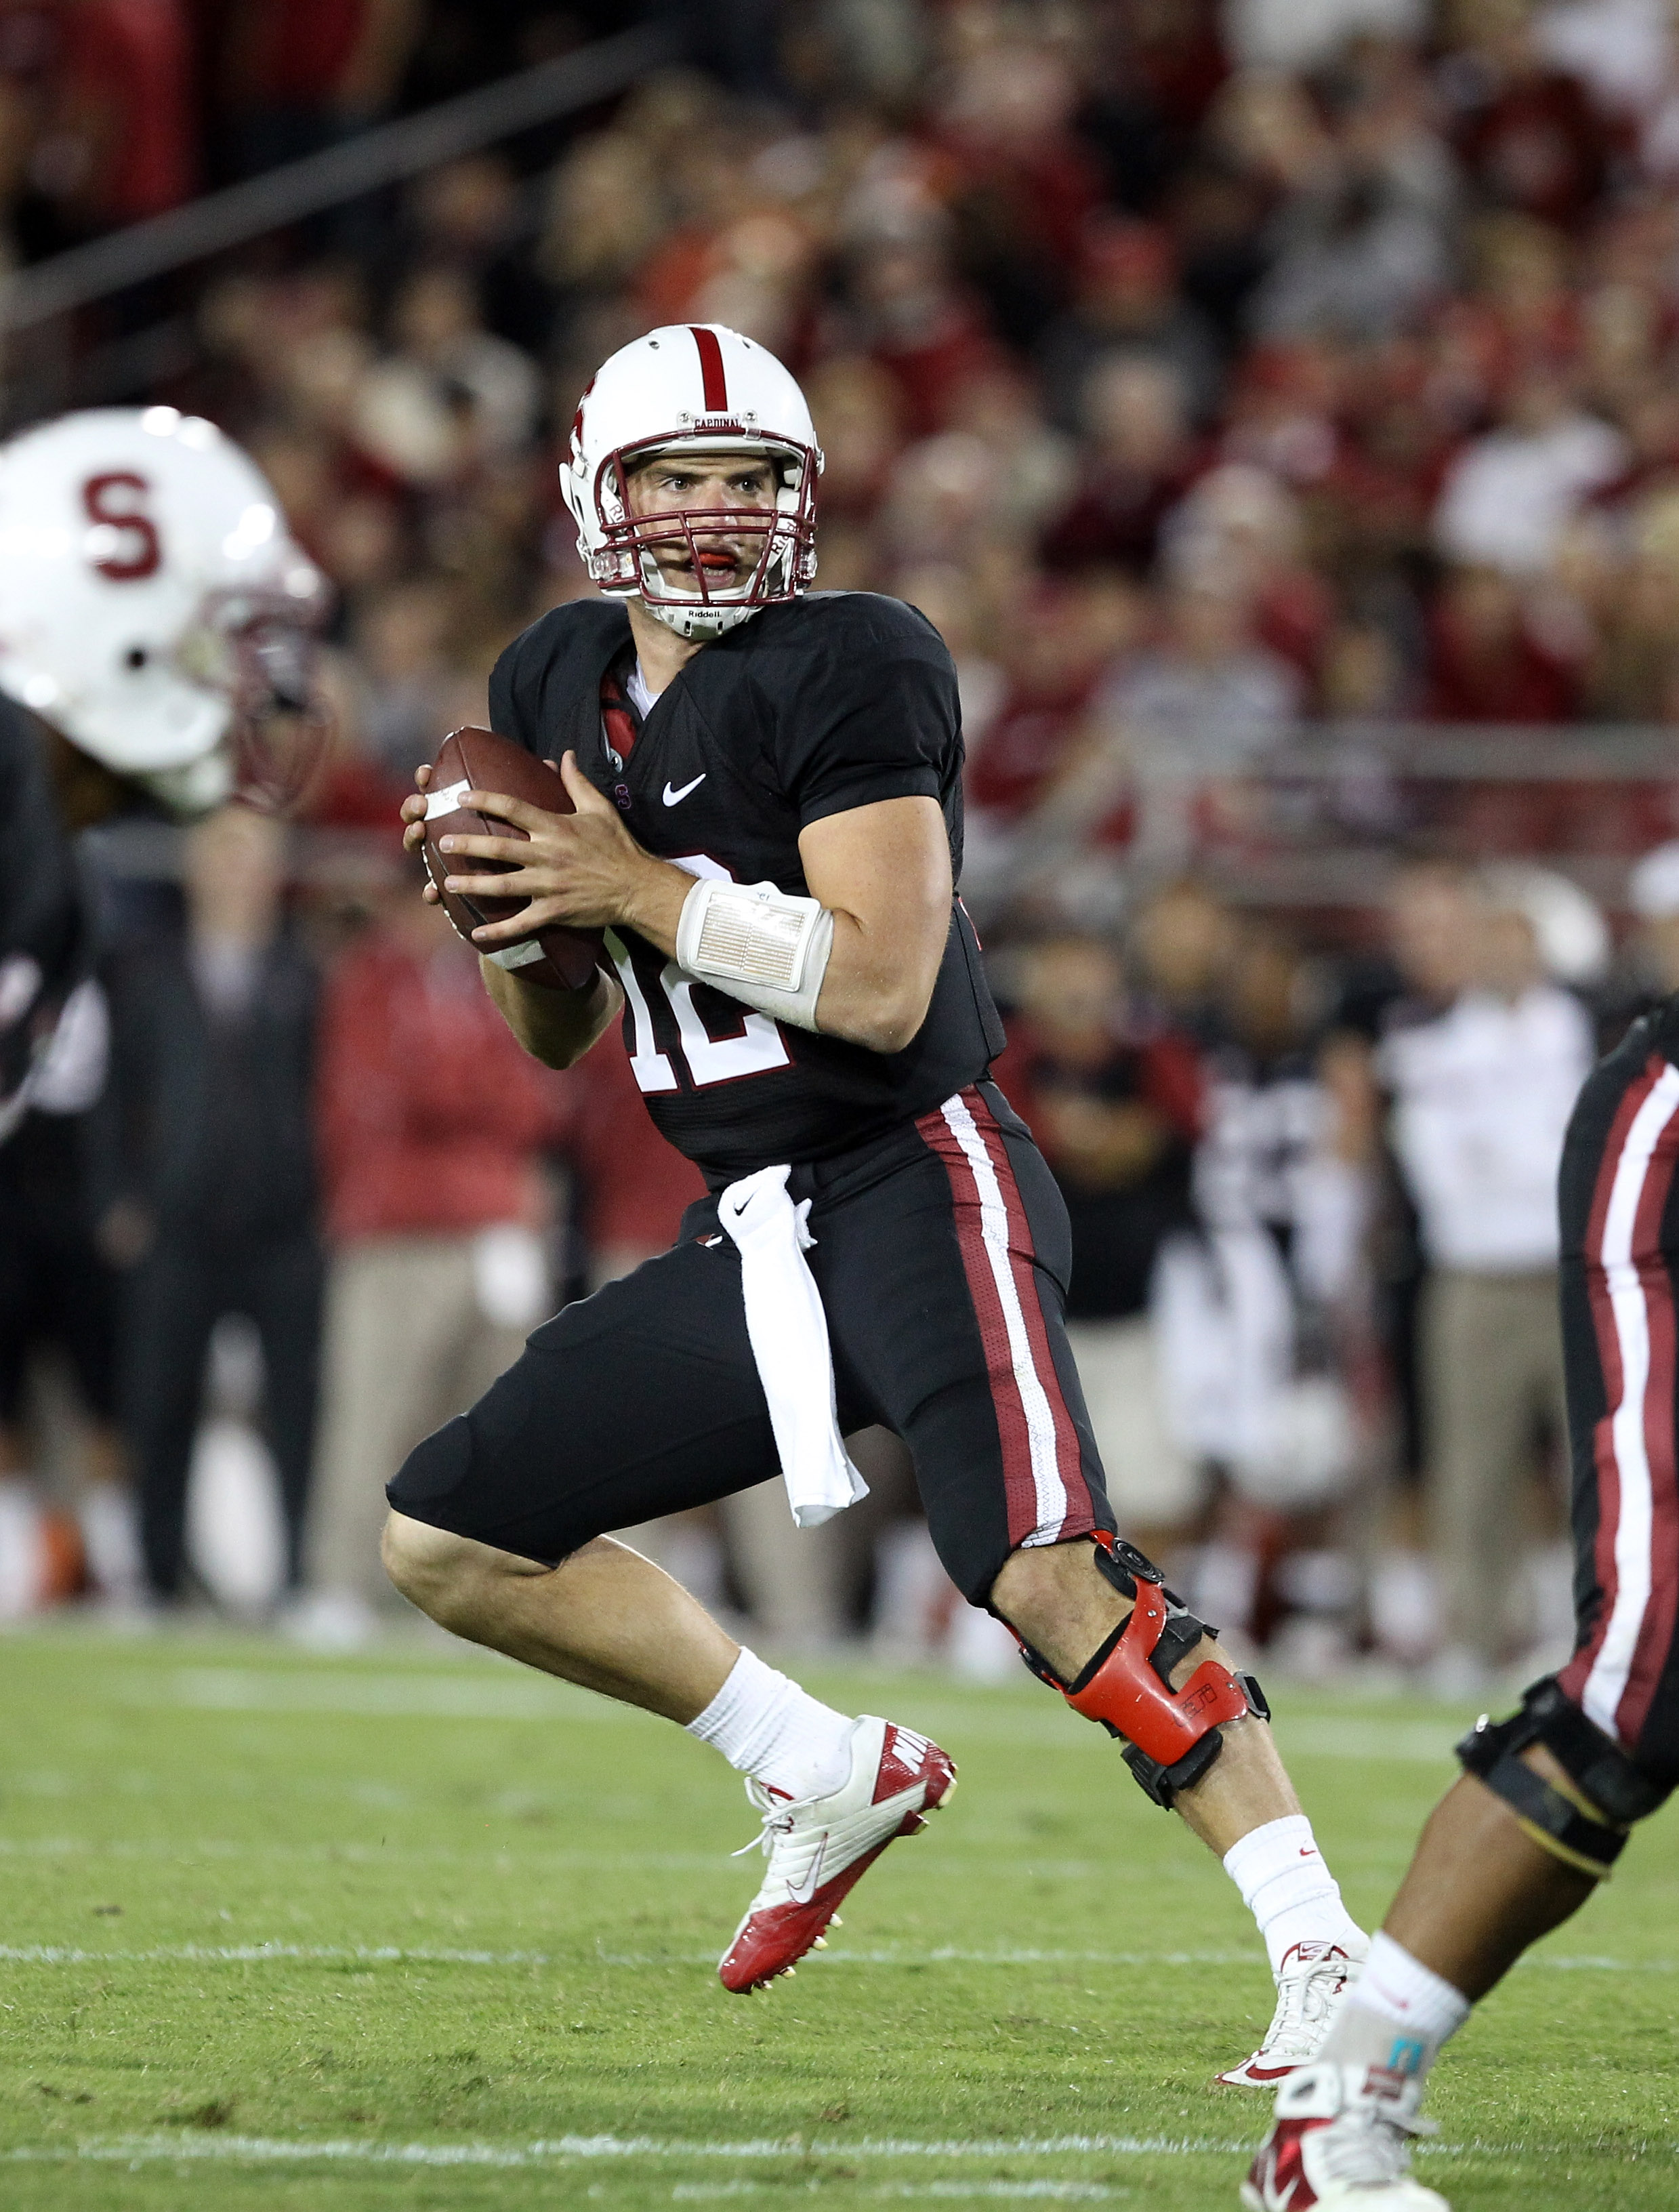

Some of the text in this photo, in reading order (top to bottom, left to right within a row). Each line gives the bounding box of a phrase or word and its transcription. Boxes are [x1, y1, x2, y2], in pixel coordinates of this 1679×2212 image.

[695, 418, 742, 428] CARDINAL
[81, 472, 160, 581] S
[615, 783, 631, 809] S
[603, 851, 794, 1095] 12
